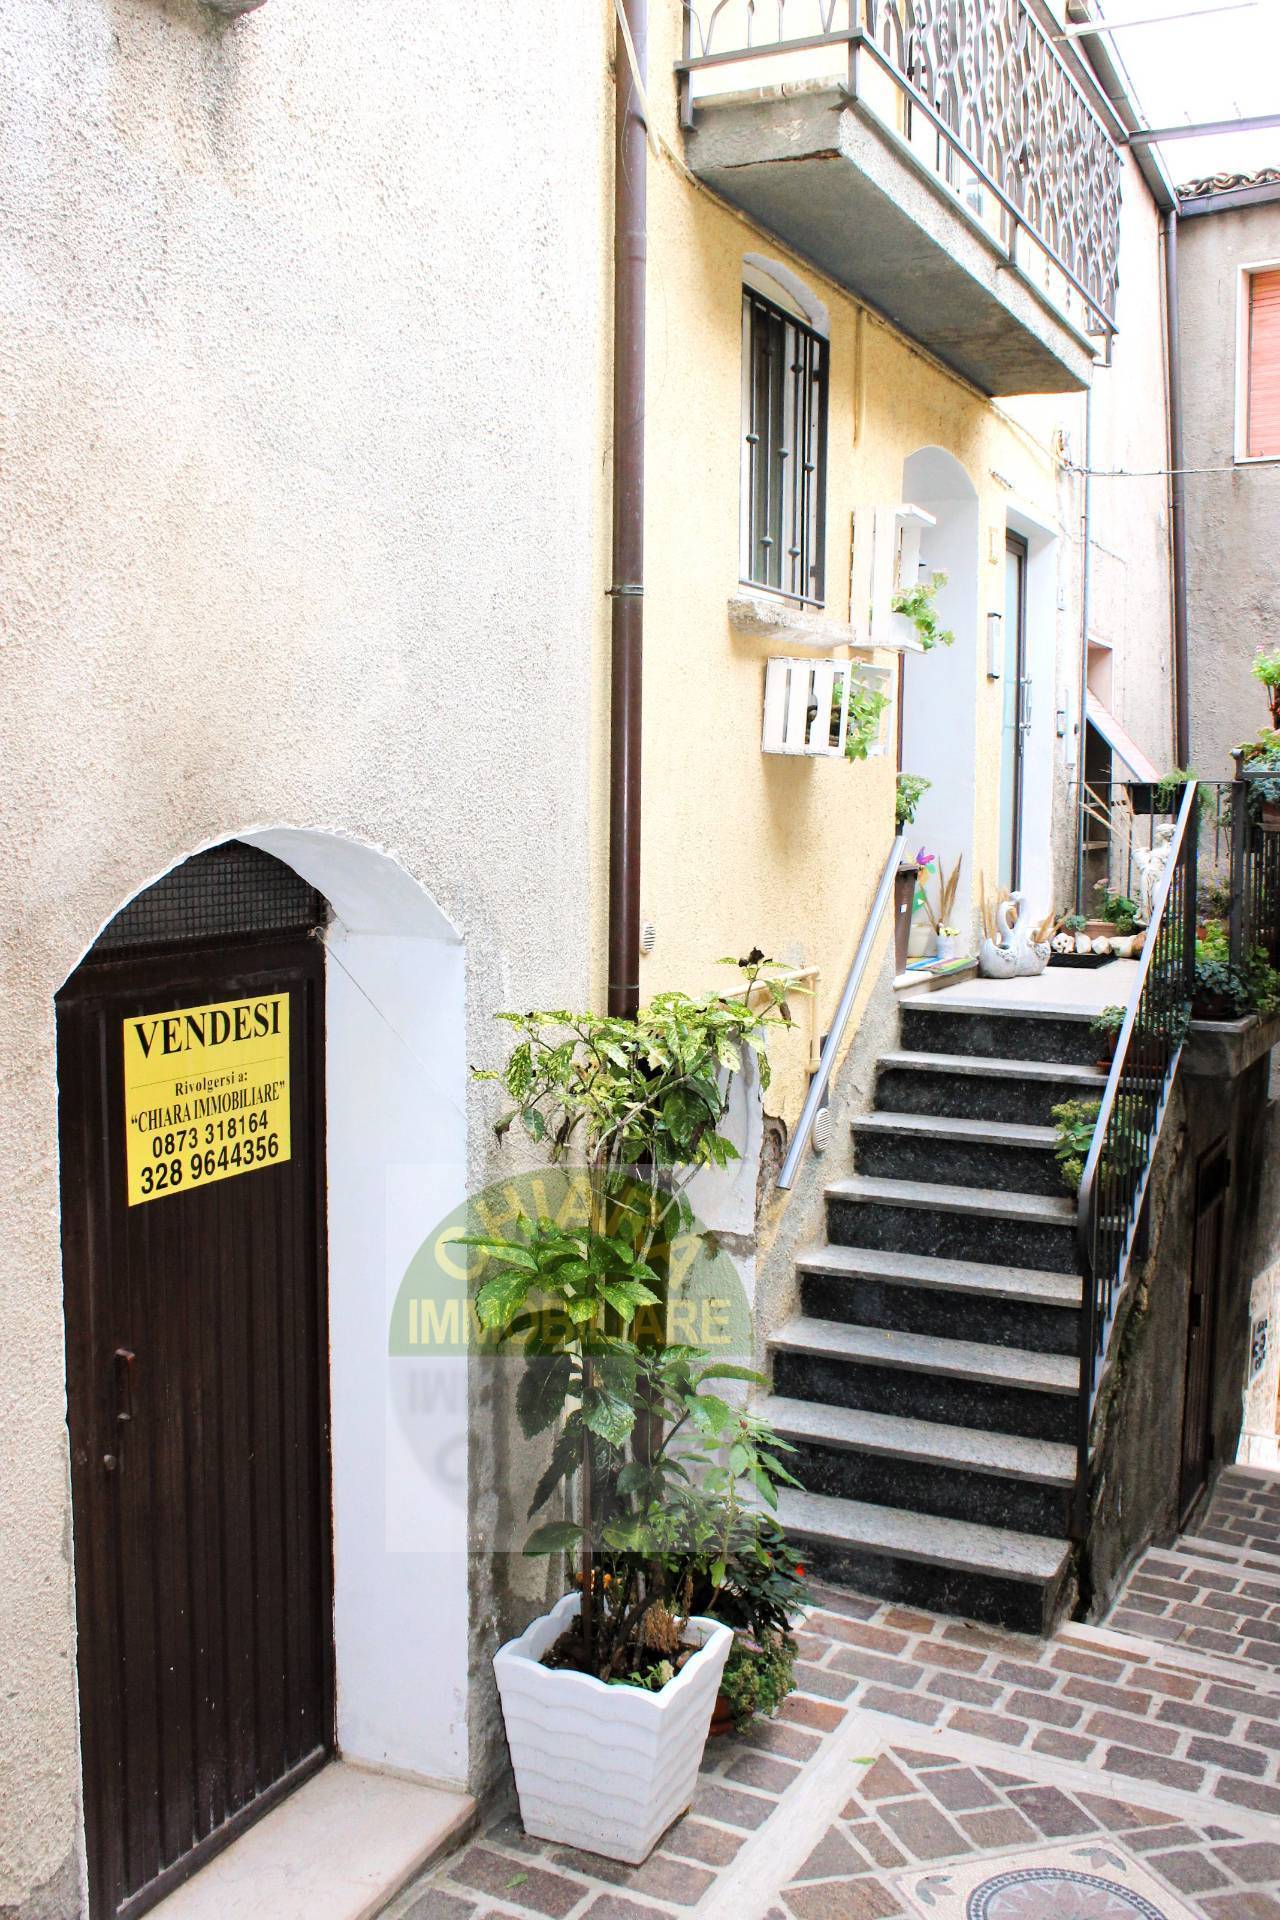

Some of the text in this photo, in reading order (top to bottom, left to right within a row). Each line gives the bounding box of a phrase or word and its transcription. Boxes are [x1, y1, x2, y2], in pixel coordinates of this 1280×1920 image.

[134, 1000, 281, 1059] VENDESI
[175, 1070, 248, 1096] Rivolgersi a:
[152, 1109, 268, 1159] 0873 318164
[141, 1132, 279, 1194] 328 9644356
